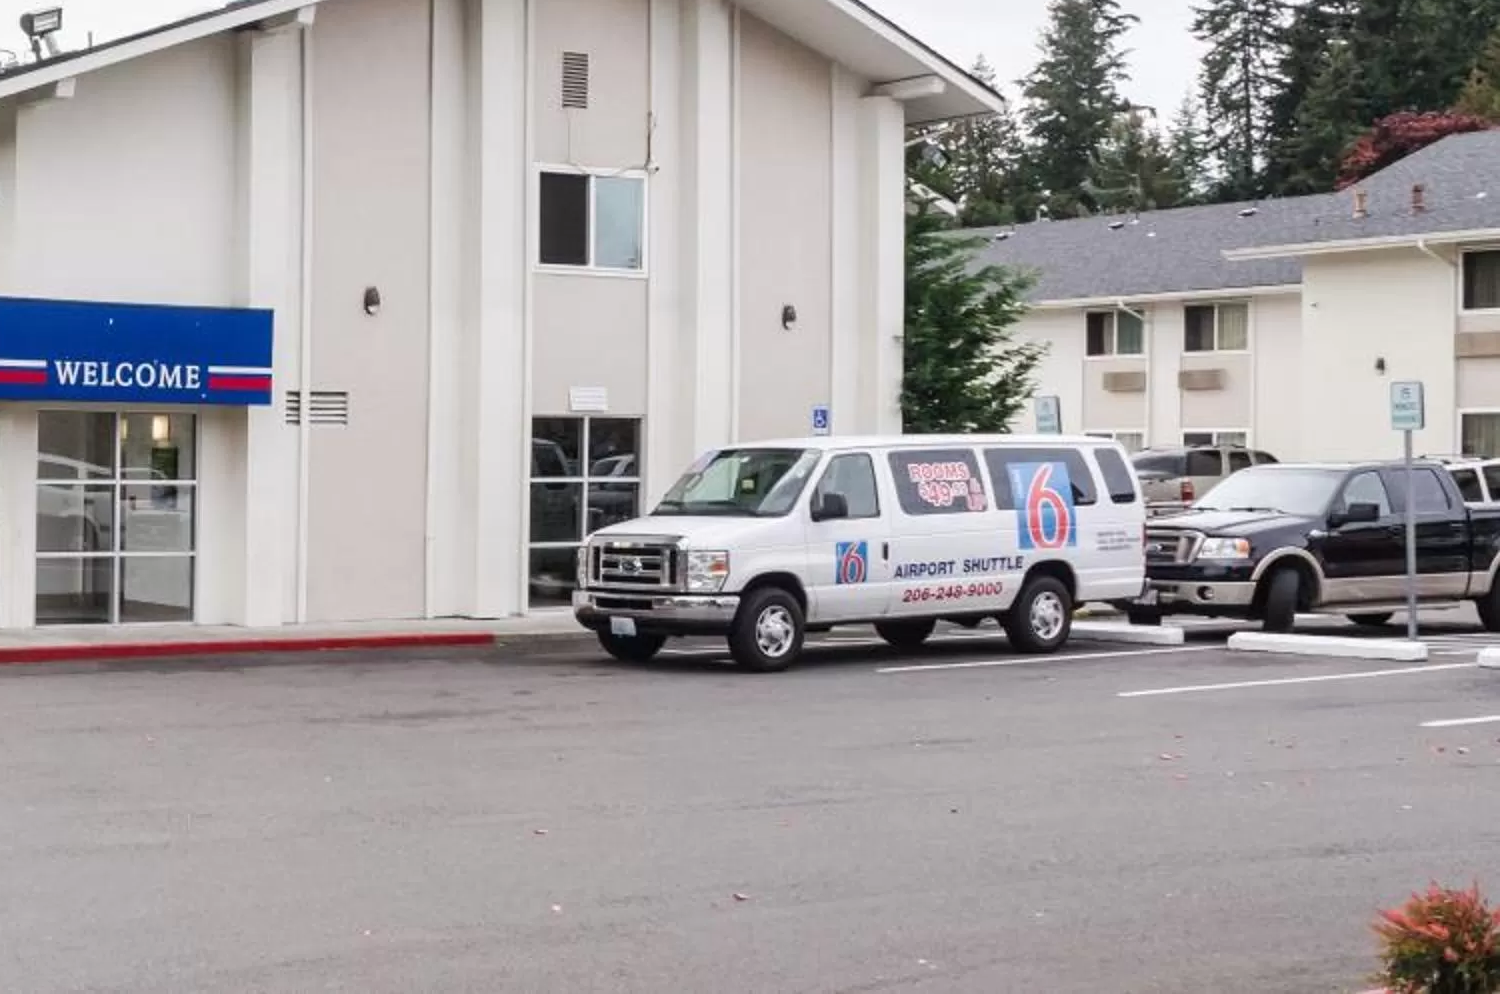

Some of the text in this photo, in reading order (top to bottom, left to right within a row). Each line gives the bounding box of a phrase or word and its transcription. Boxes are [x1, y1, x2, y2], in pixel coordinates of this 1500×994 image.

[54, 360, 201, 389] WELCOME
[908, 462, 970, 482] ROOMS
[1027, 462, 1069, 551] 6
[842, 541, 865, 586] 6
[894, 556, 1024, 579] AIRPORT SHUTTLE
[902, 581, 1003, 603] 206-248-9000
